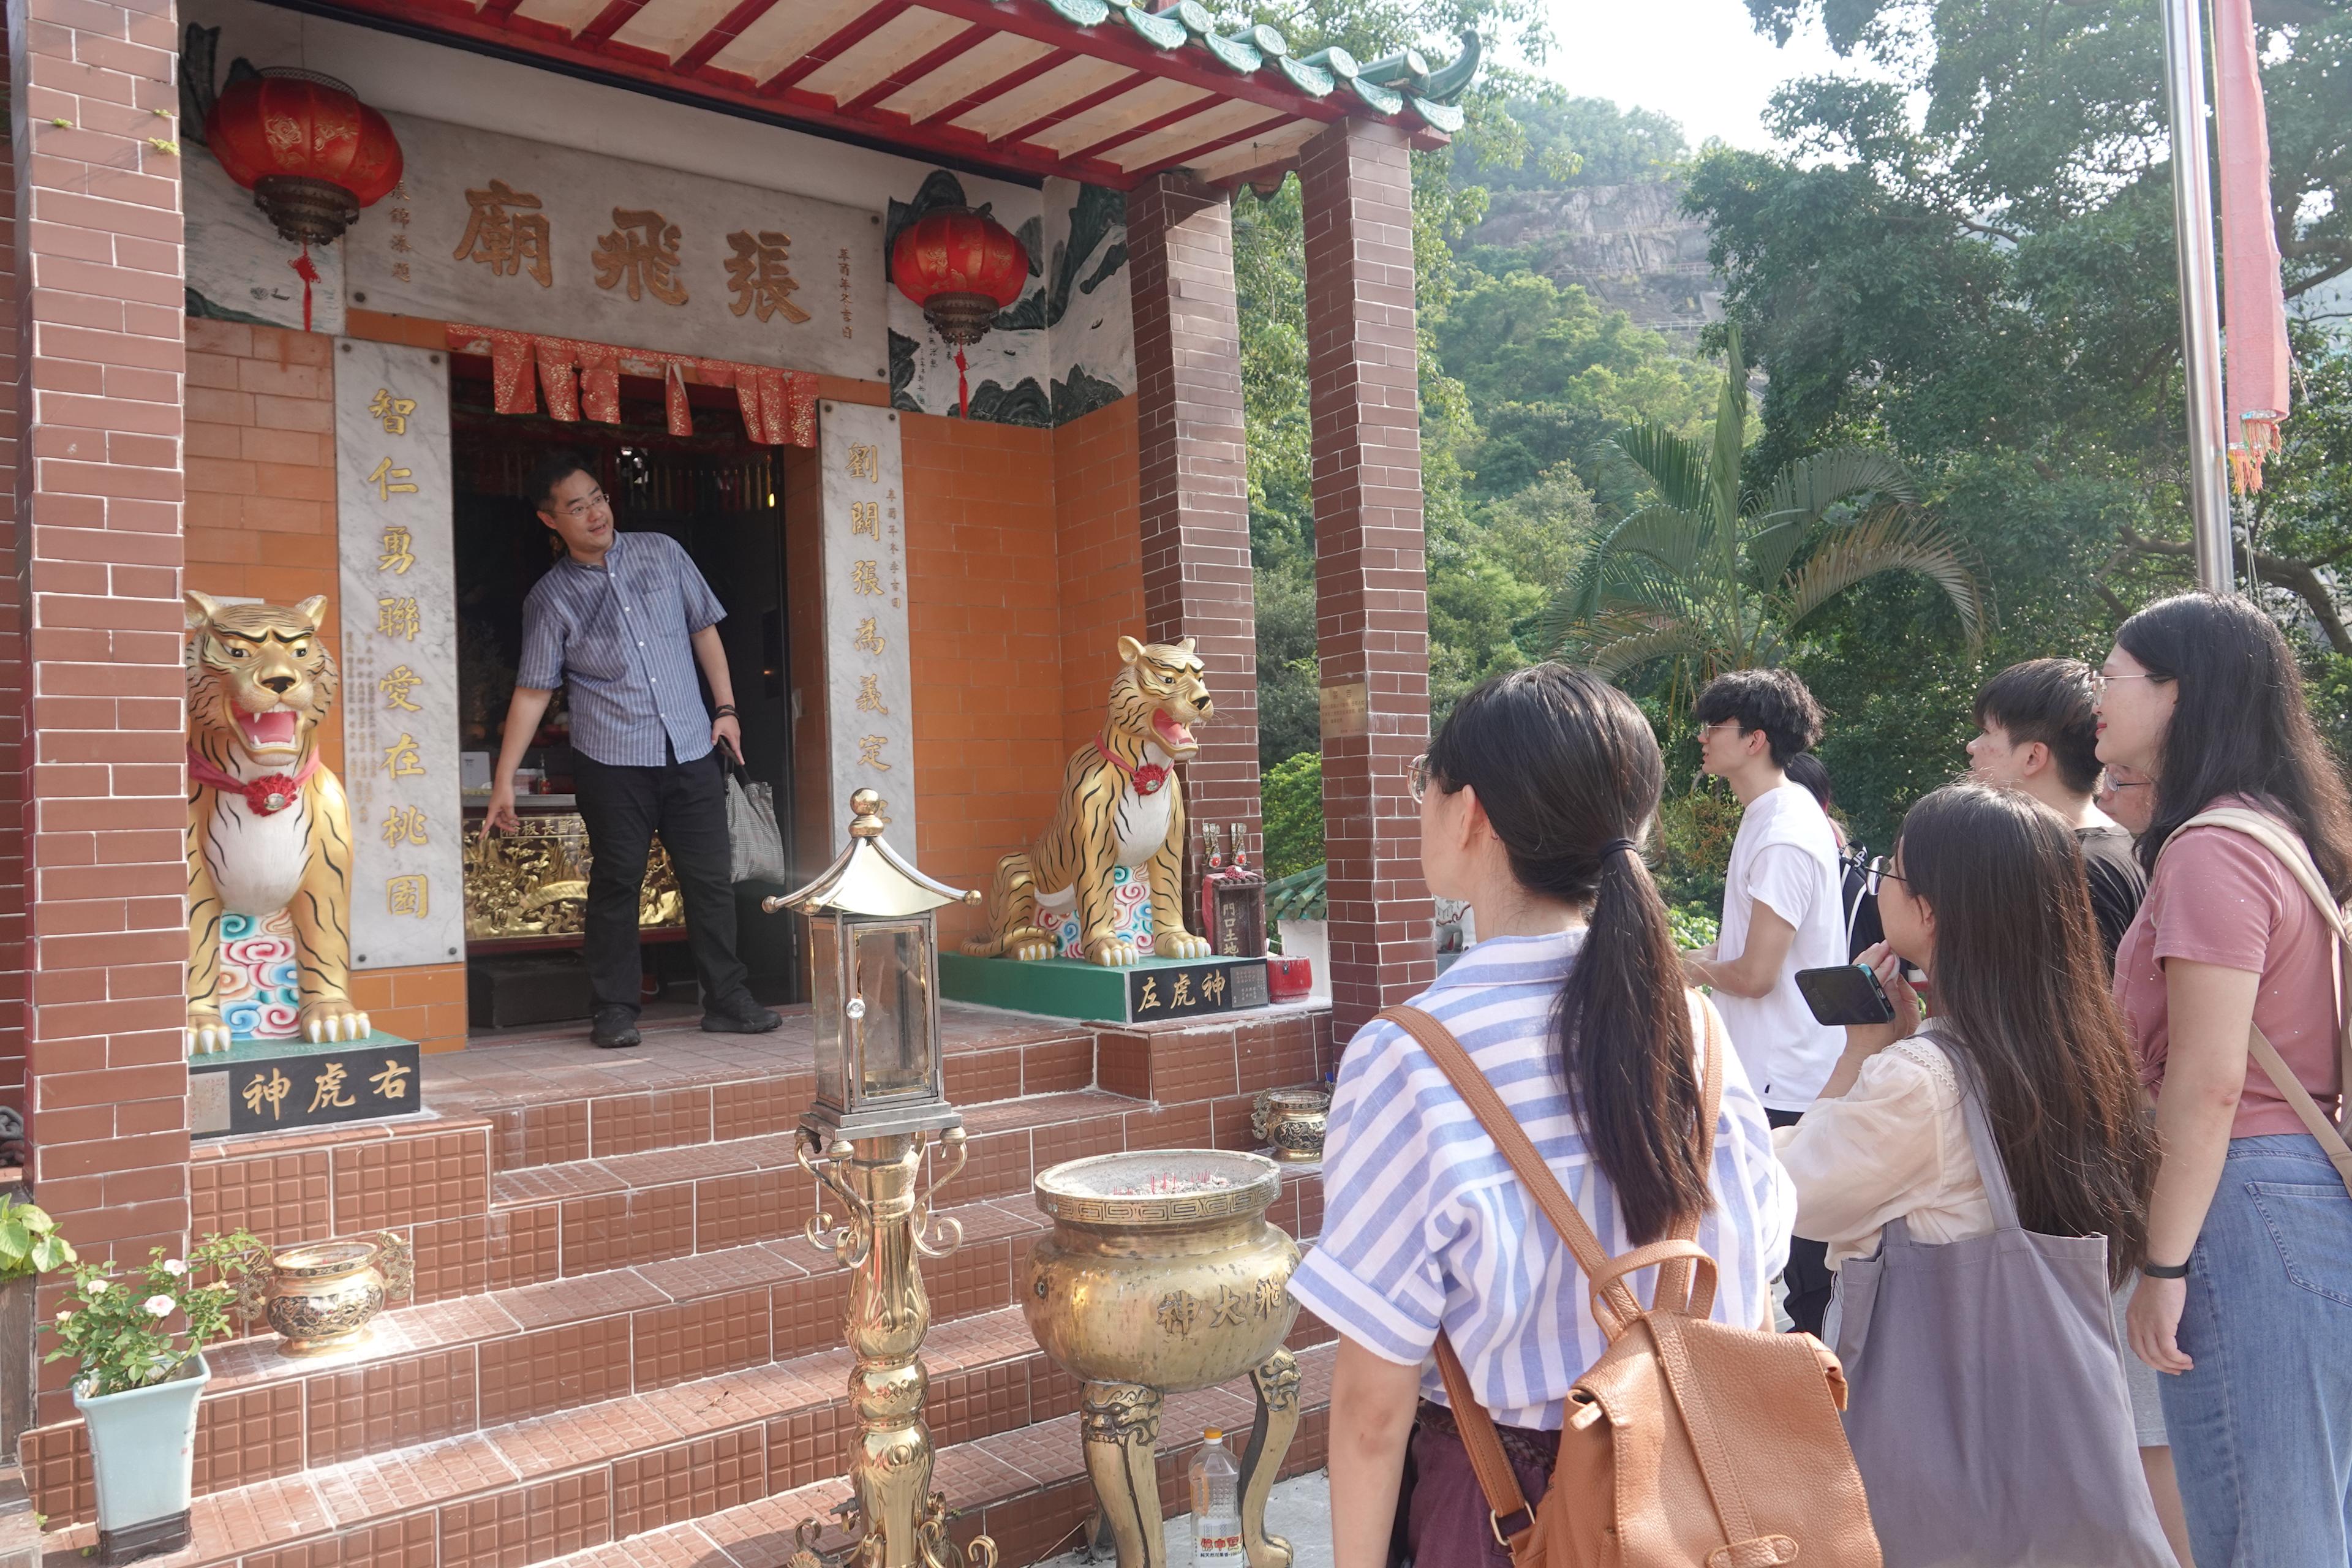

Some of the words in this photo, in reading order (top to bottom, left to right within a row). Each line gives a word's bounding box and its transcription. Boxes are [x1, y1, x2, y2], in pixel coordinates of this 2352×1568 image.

[453, 178, 812, 323] 張飛廟
[368, 387, 430, 919] 智仁勇聯愛在桃園
[1223, 902, 1240, 957] 門口土地
[1137, 969, 1226, 1013] 左虎神
[1156, 1272, 1294, 1335] 飛大神
